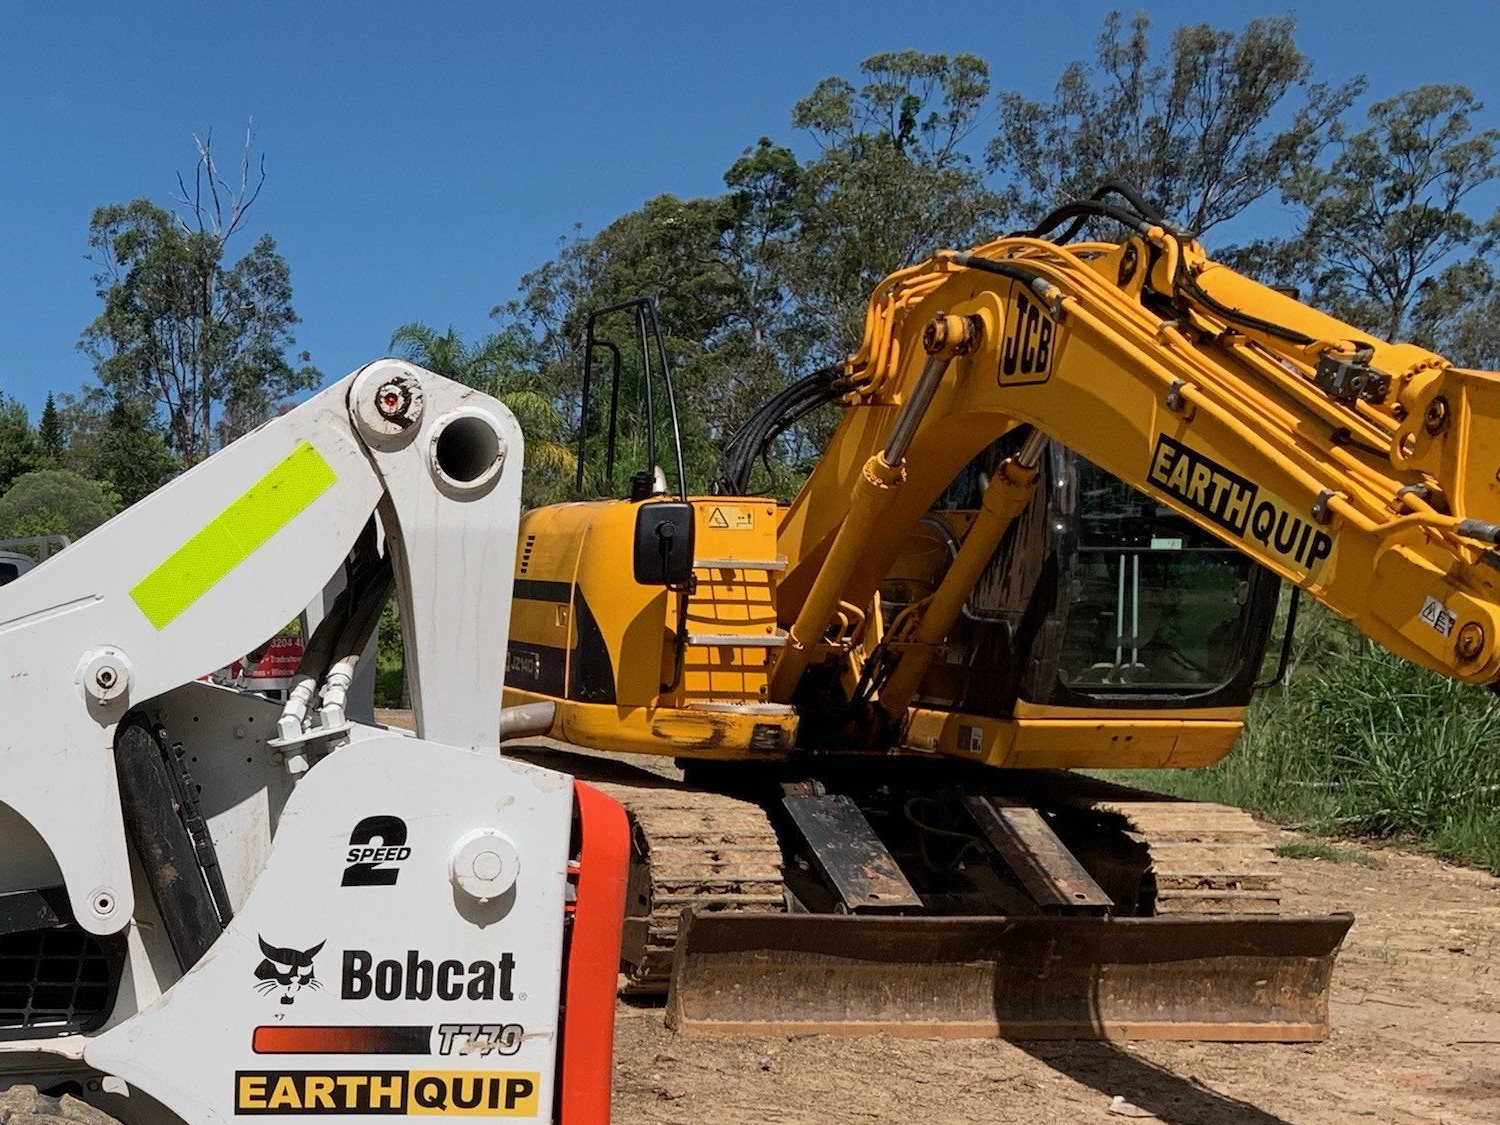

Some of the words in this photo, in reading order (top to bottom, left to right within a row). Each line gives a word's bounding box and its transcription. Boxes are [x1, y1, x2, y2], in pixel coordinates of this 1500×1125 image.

[1003, 291, 1052, 376] JCB
[341, 815, 407, 887] 2
[346, 847, 412, 862] SPEED
[341, 950, 515, 1001] Bobcat
[438, 1023, 524, 1057] T770
